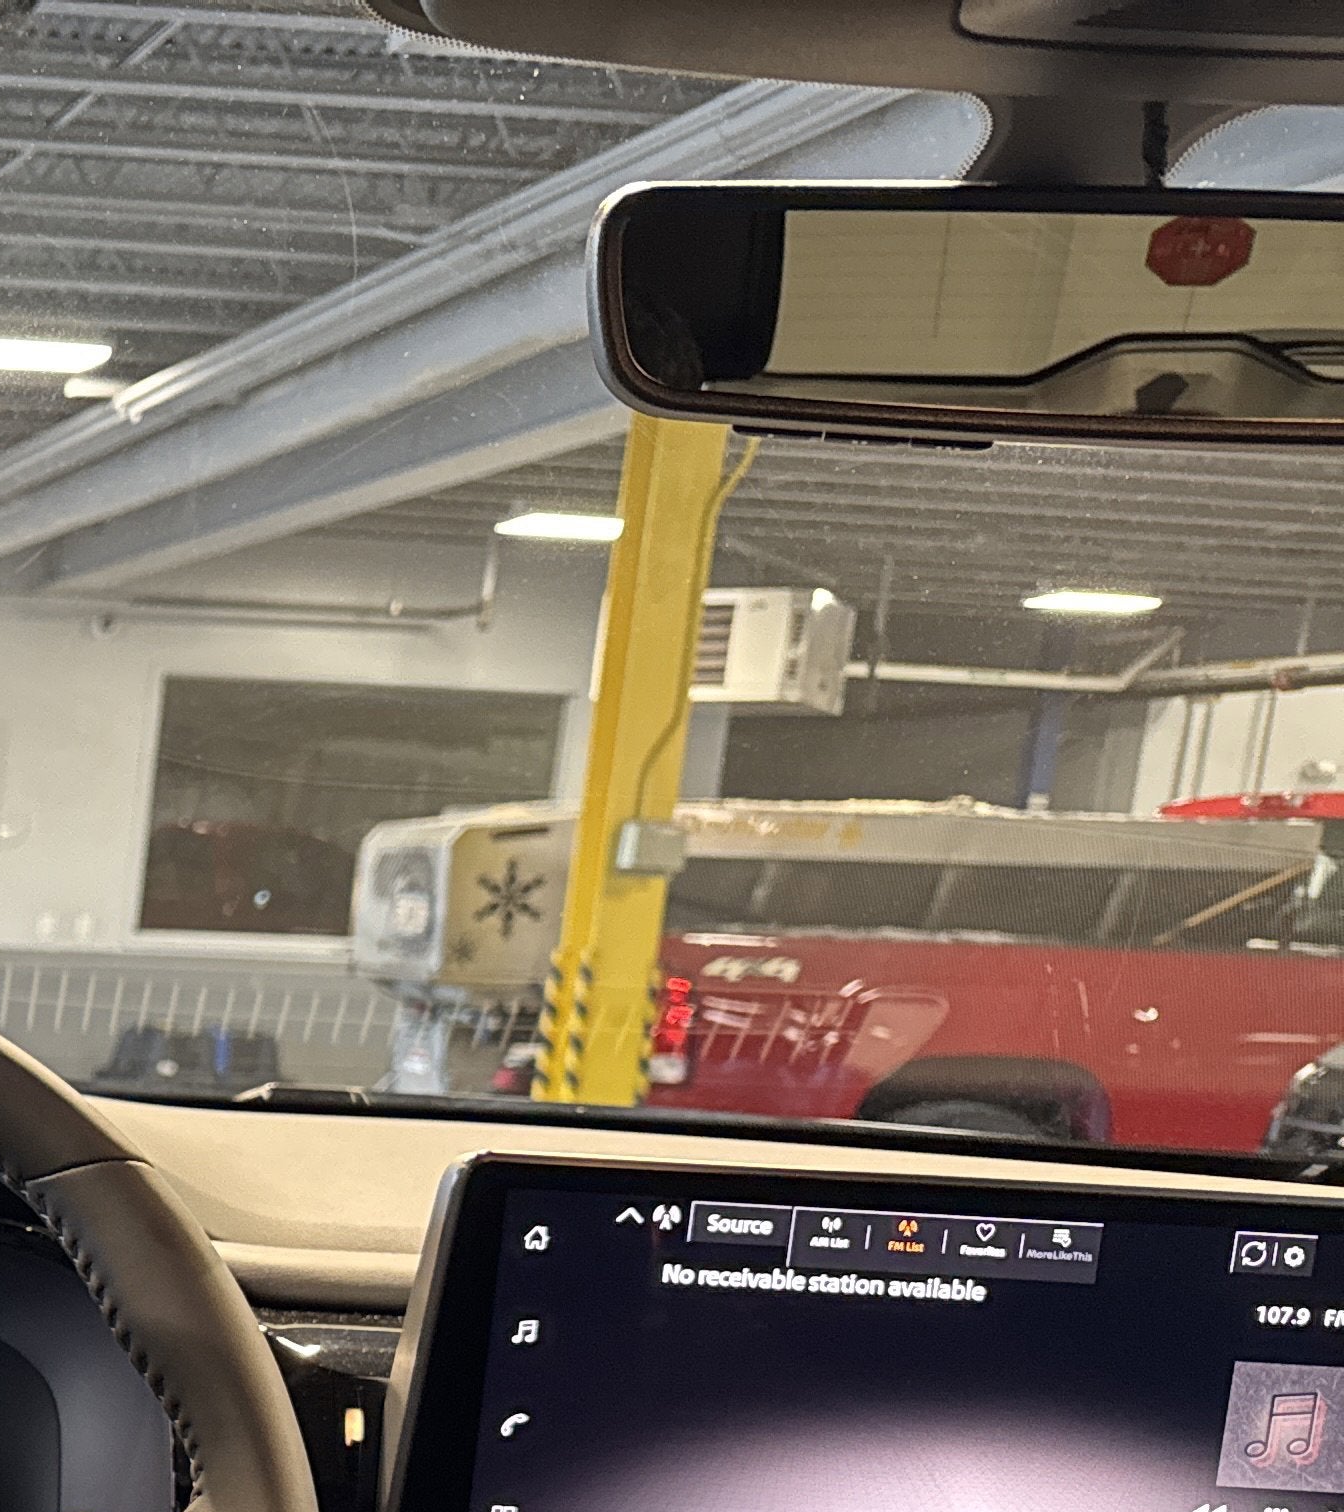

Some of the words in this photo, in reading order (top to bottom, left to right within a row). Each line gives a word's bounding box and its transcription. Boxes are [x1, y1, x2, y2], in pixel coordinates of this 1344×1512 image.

[706, 1213, 774, 1237] Source
[829, 1237, 850, 1250] List
[888, 1240, 905, 1252] FM
[906, 1241, 925, 1253] List
[959, 1244, 1007, 1259] Favorites
[662, 1263, 695, 1285] No
[697, 1266, 806, 1292] receivable
[808, 1273, 885, 1297] station
[887, 1277, 987, 1302] available
[1256, 1305, 1311, 1327] 107.9
